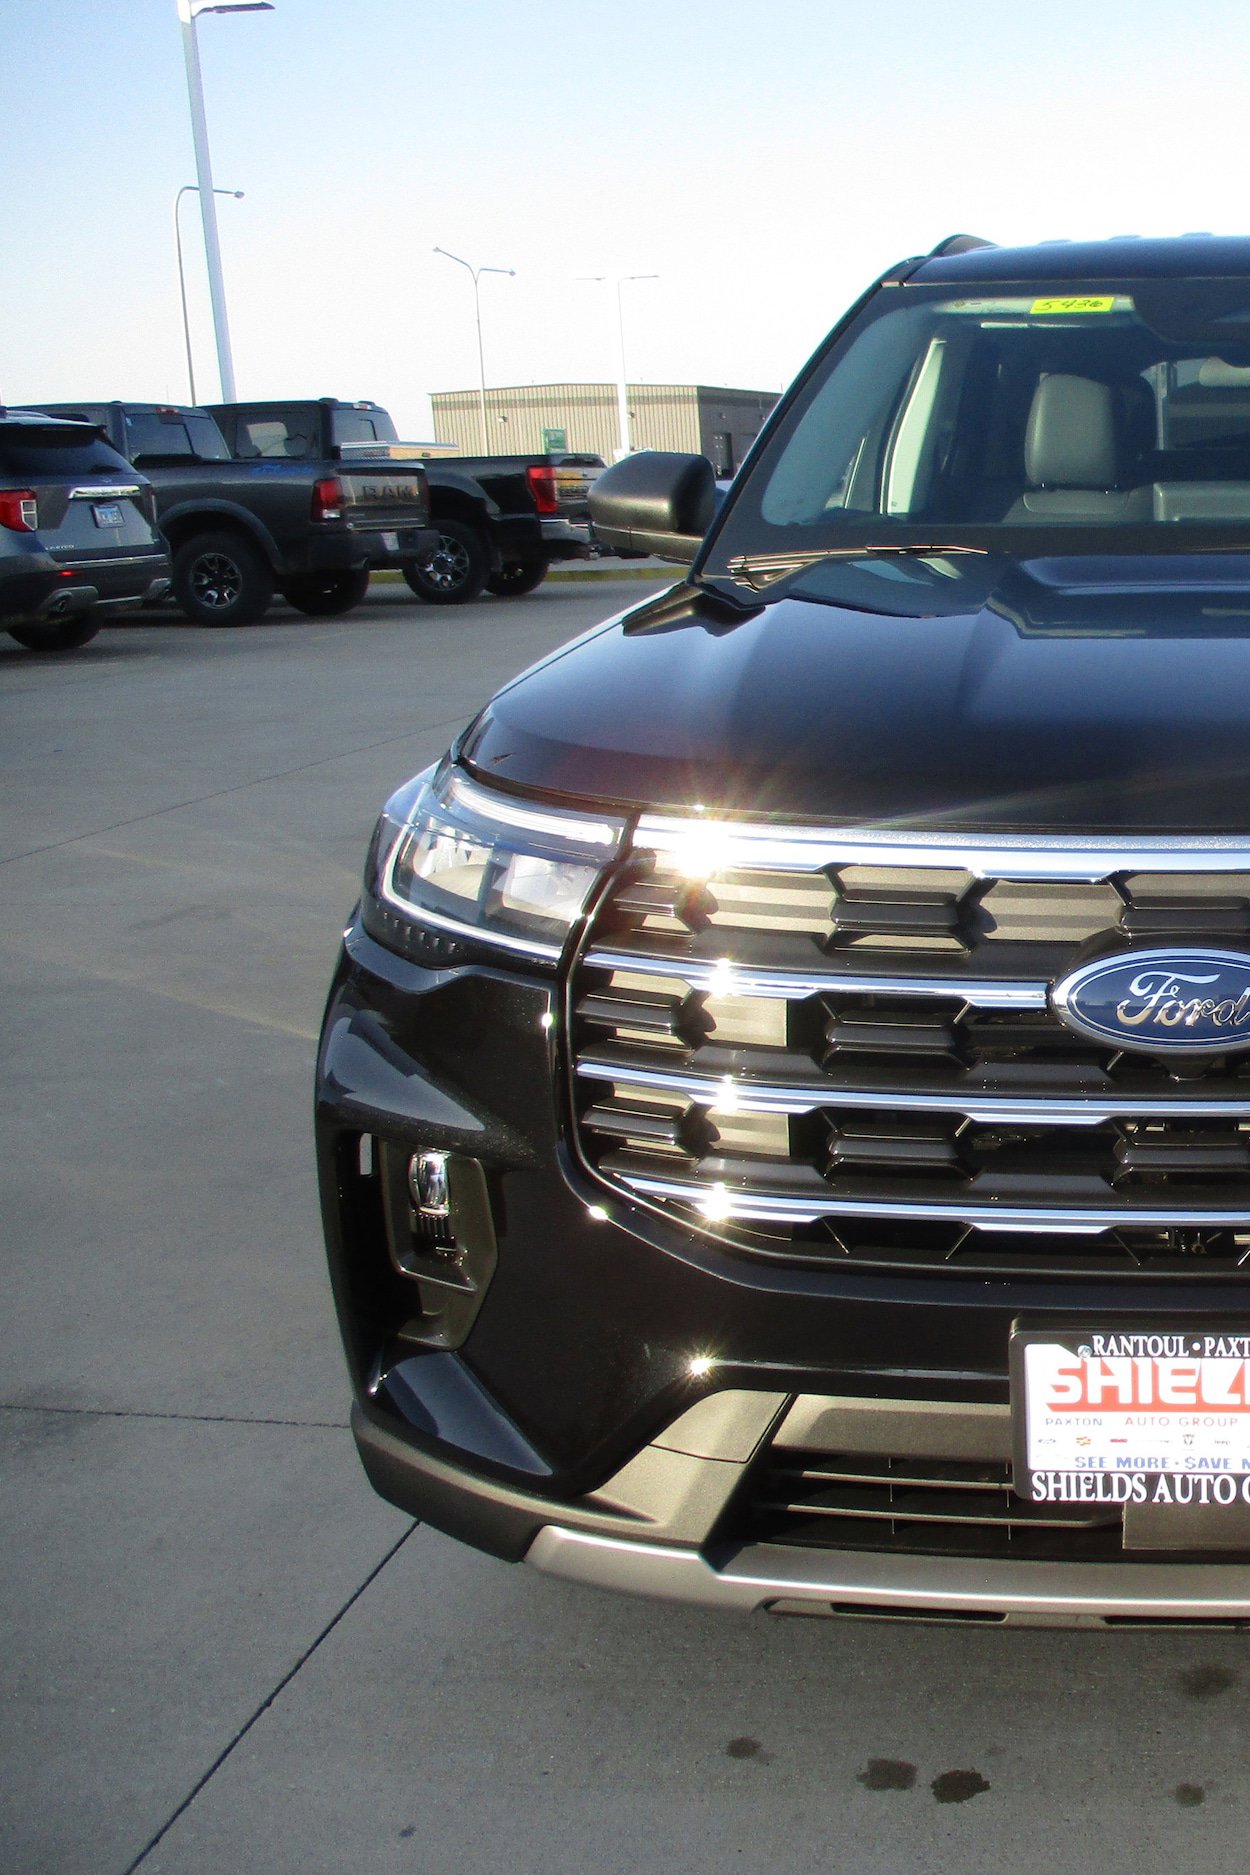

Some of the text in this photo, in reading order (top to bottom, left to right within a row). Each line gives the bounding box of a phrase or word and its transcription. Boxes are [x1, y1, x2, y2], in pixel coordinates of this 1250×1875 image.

[1092, 1335, 1189, 1357] RANTOUL
[1045, 1418, 1103, 1426] PAXTON
[1124, 1416, 1171, 1427] AUTO
[1178, 1416, 1239, 1428] GROUP
[1074, 1456, 1108, 1469] SEE
[1116, 1456, 1170, 1470] MORE
[1031, 1471, 1148, 1503] SHIELDS
[1151, 1472, 1238, 1505] AUTO
